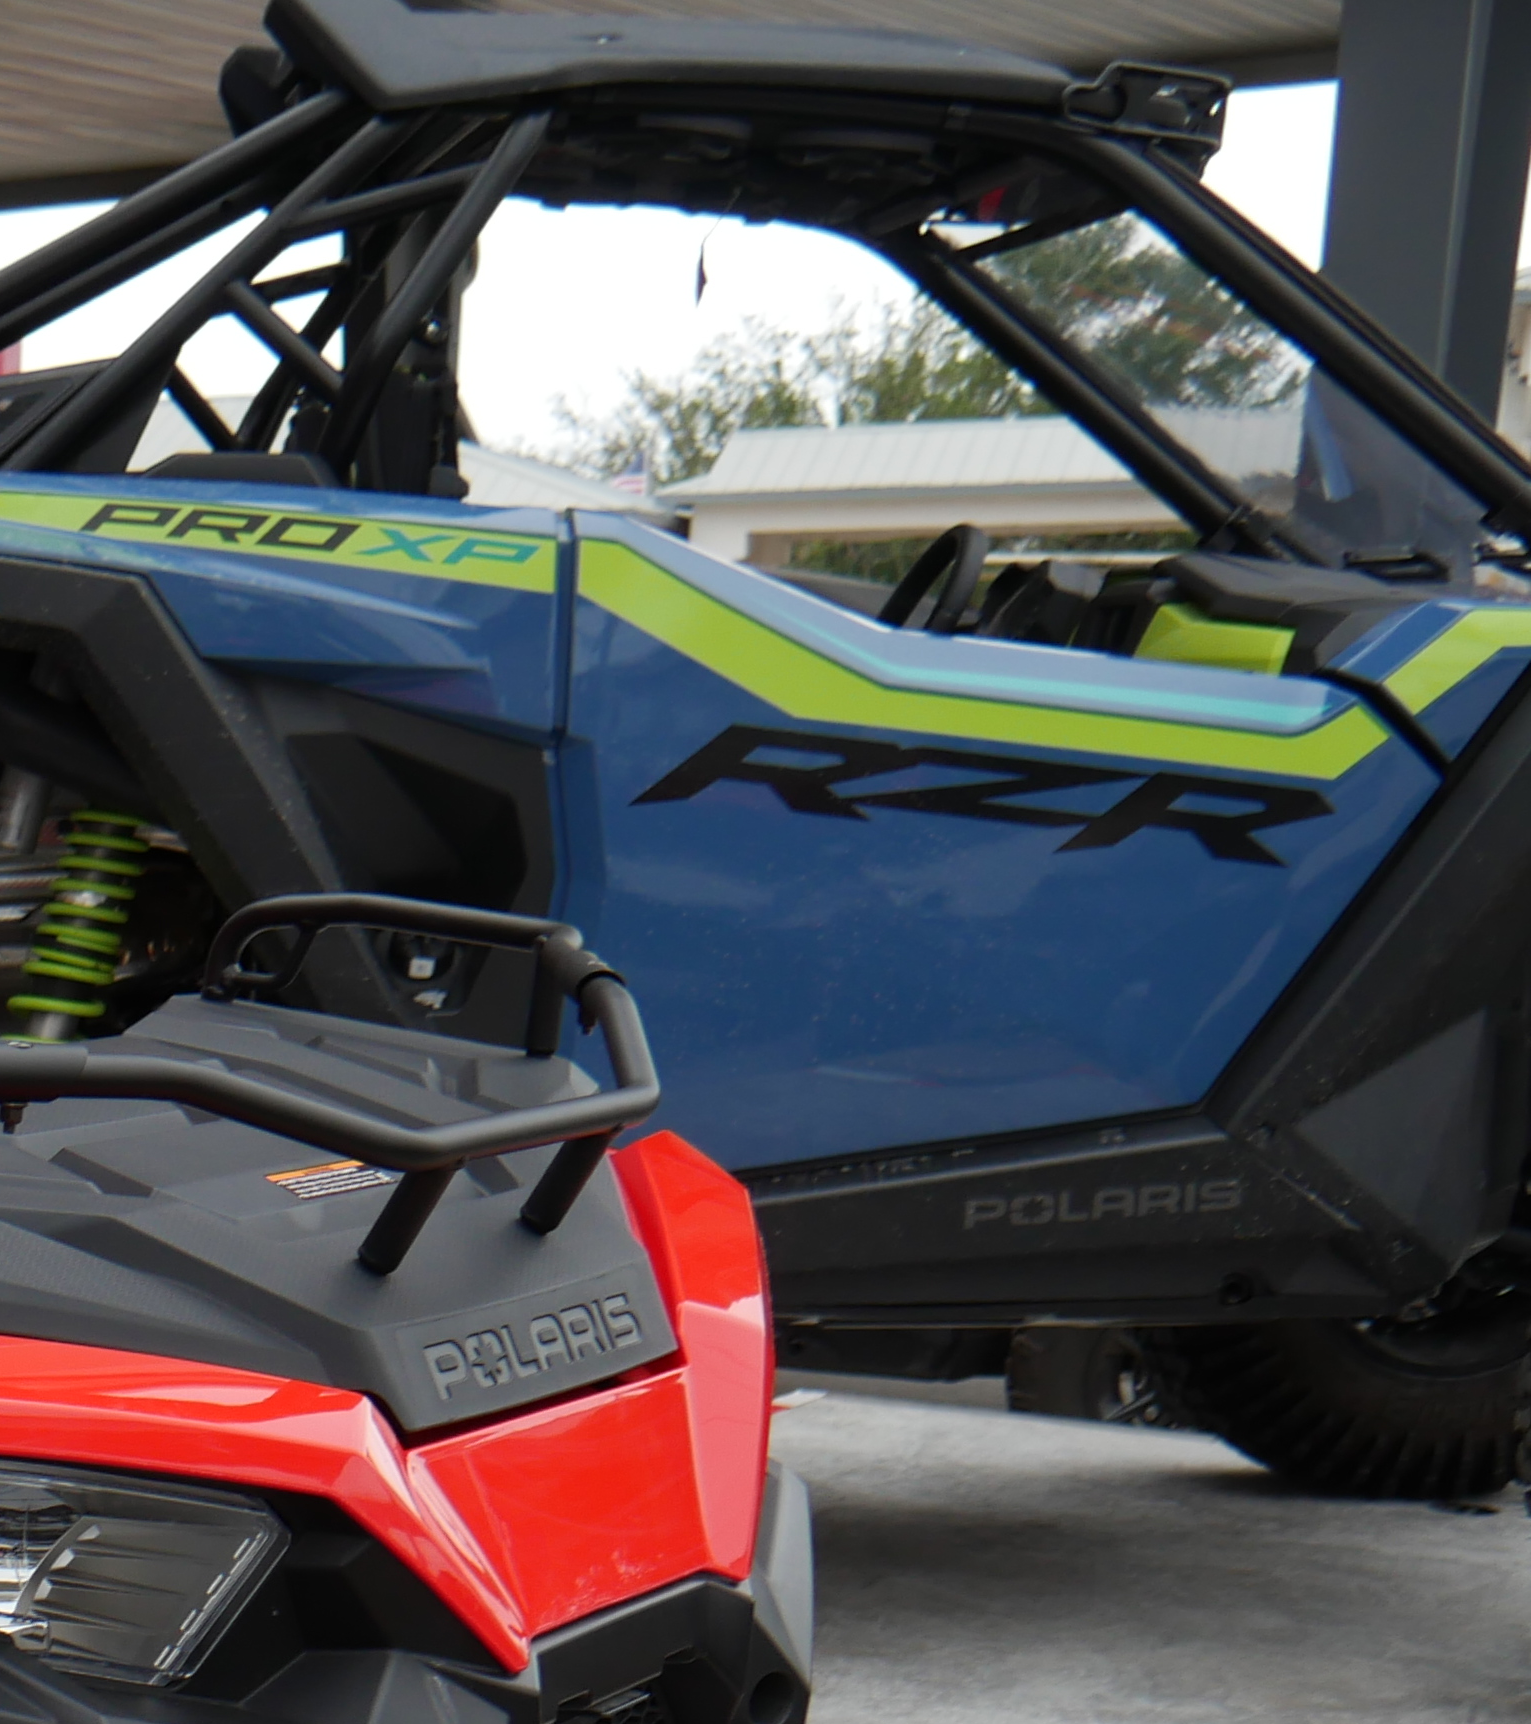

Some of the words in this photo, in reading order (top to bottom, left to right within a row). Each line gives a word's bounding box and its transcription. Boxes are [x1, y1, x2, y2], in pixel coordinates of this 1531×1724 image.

[78, 502, 363, 553] PRO
[356, 527, 541, 565] XP
[632, 723, 1338, 868] RZR
[962, 1179, 1241, 1231] POLARIS
[423, 1291, 643, 1401] POLARIS
